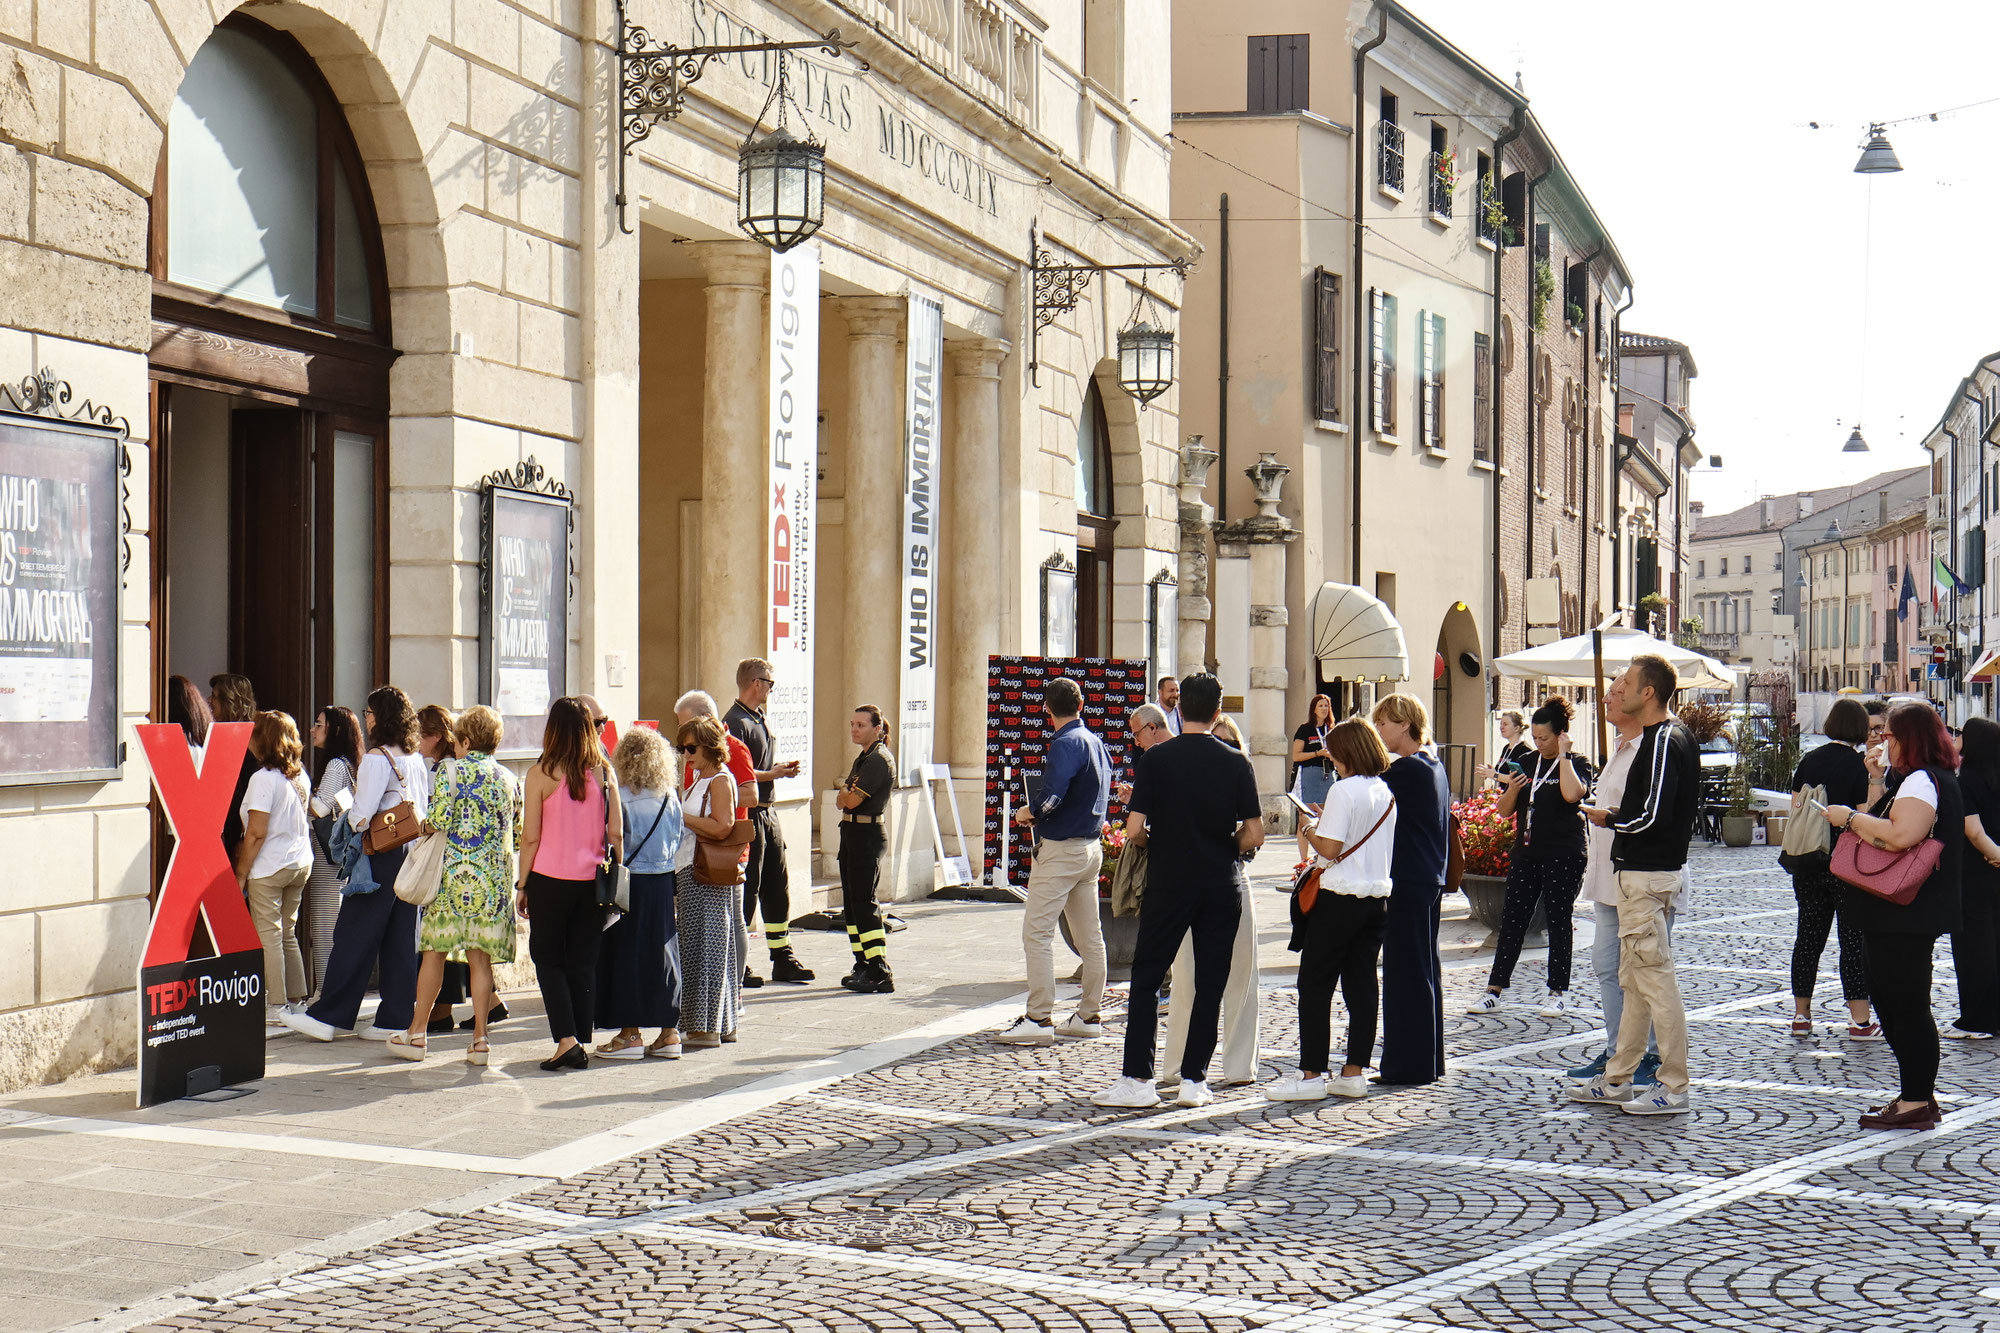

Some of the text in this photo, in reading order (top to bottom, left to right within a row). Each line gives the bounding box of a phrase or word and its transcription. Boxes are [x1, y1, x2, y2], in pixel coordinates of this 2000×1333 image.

[879, 105, 998, 218] MDCCCXIX
[773, 263, 799, 651] TEDx Rovigo
[0, 475, 39, 532] WHO
[910, 357, 932, 670] WHO IS IMMORTAL
[500, 536, 526, 577] WHO
[793, 489, 801, 622] independently
[501, 576, 513, 617] IS
[500, 617, 550, 659] IMMORTAL
[1000, 678, 1022, 688] Rovigo
[1084, 680, 1104, 691] Rovigo
[1124, 682, 1144, 692] Rovigo
[1022, 666, 1044, 676] Rovigo
[1064, 667, 1086, 678] Rovigo
[1106, 668, 1126, 678] Rovigo
[1000, 704, 1021, 714] Rovigo
[1084, 706, 1104, 716] Rovigo
[1022, 692, 1043, 702] Rovigo
[1105, 693, 1125, 704] Rovigo
[999, 730, 1020, 740] Rovigo
[1022, 717, 1042, 728] Rovigo
[1104, 718, 1124, 728] Rovigo
[1021, 742, 1042, 753] Rovigo
[146, 970, 260, 1016] TEDx Rovigo
[147, 1026, 205, 1048] organized TED event
[156, 1014, 197, 1031] independently
